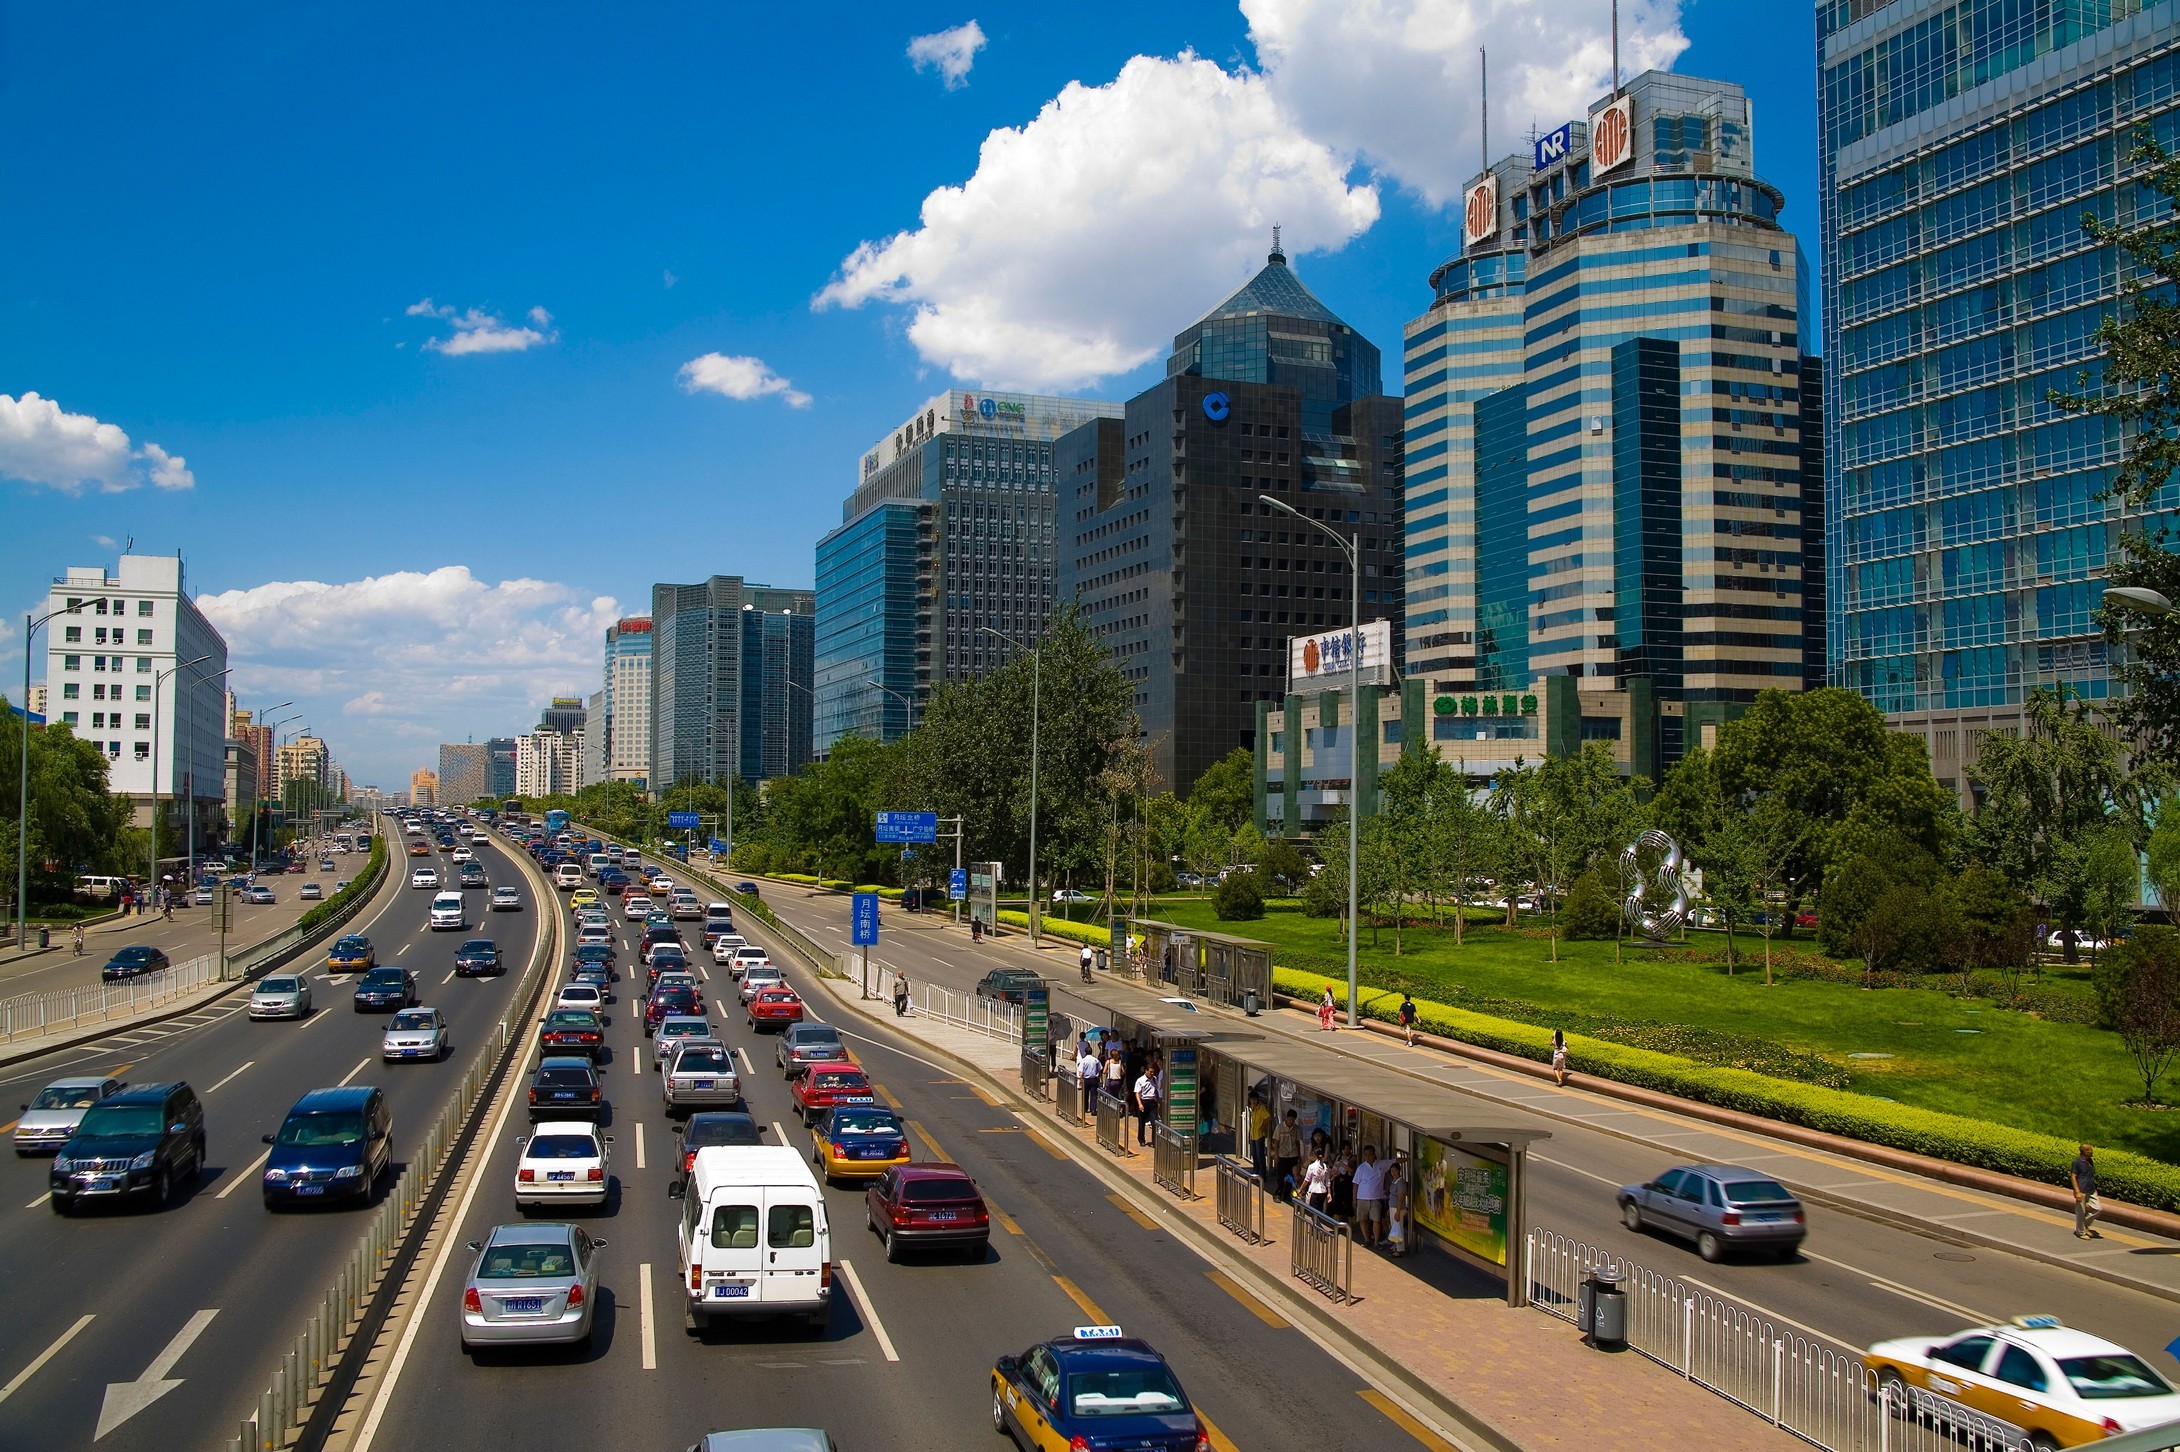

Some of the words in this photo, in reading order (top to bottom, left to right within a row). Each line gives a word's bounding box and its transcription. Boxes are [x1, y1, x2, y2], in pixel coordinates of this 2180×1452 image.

[1541, 130, 1565, 164] NR
[1461, 695, 1538, 716] 格林期货
[860, 898, 870, 939] 月坛南桥
